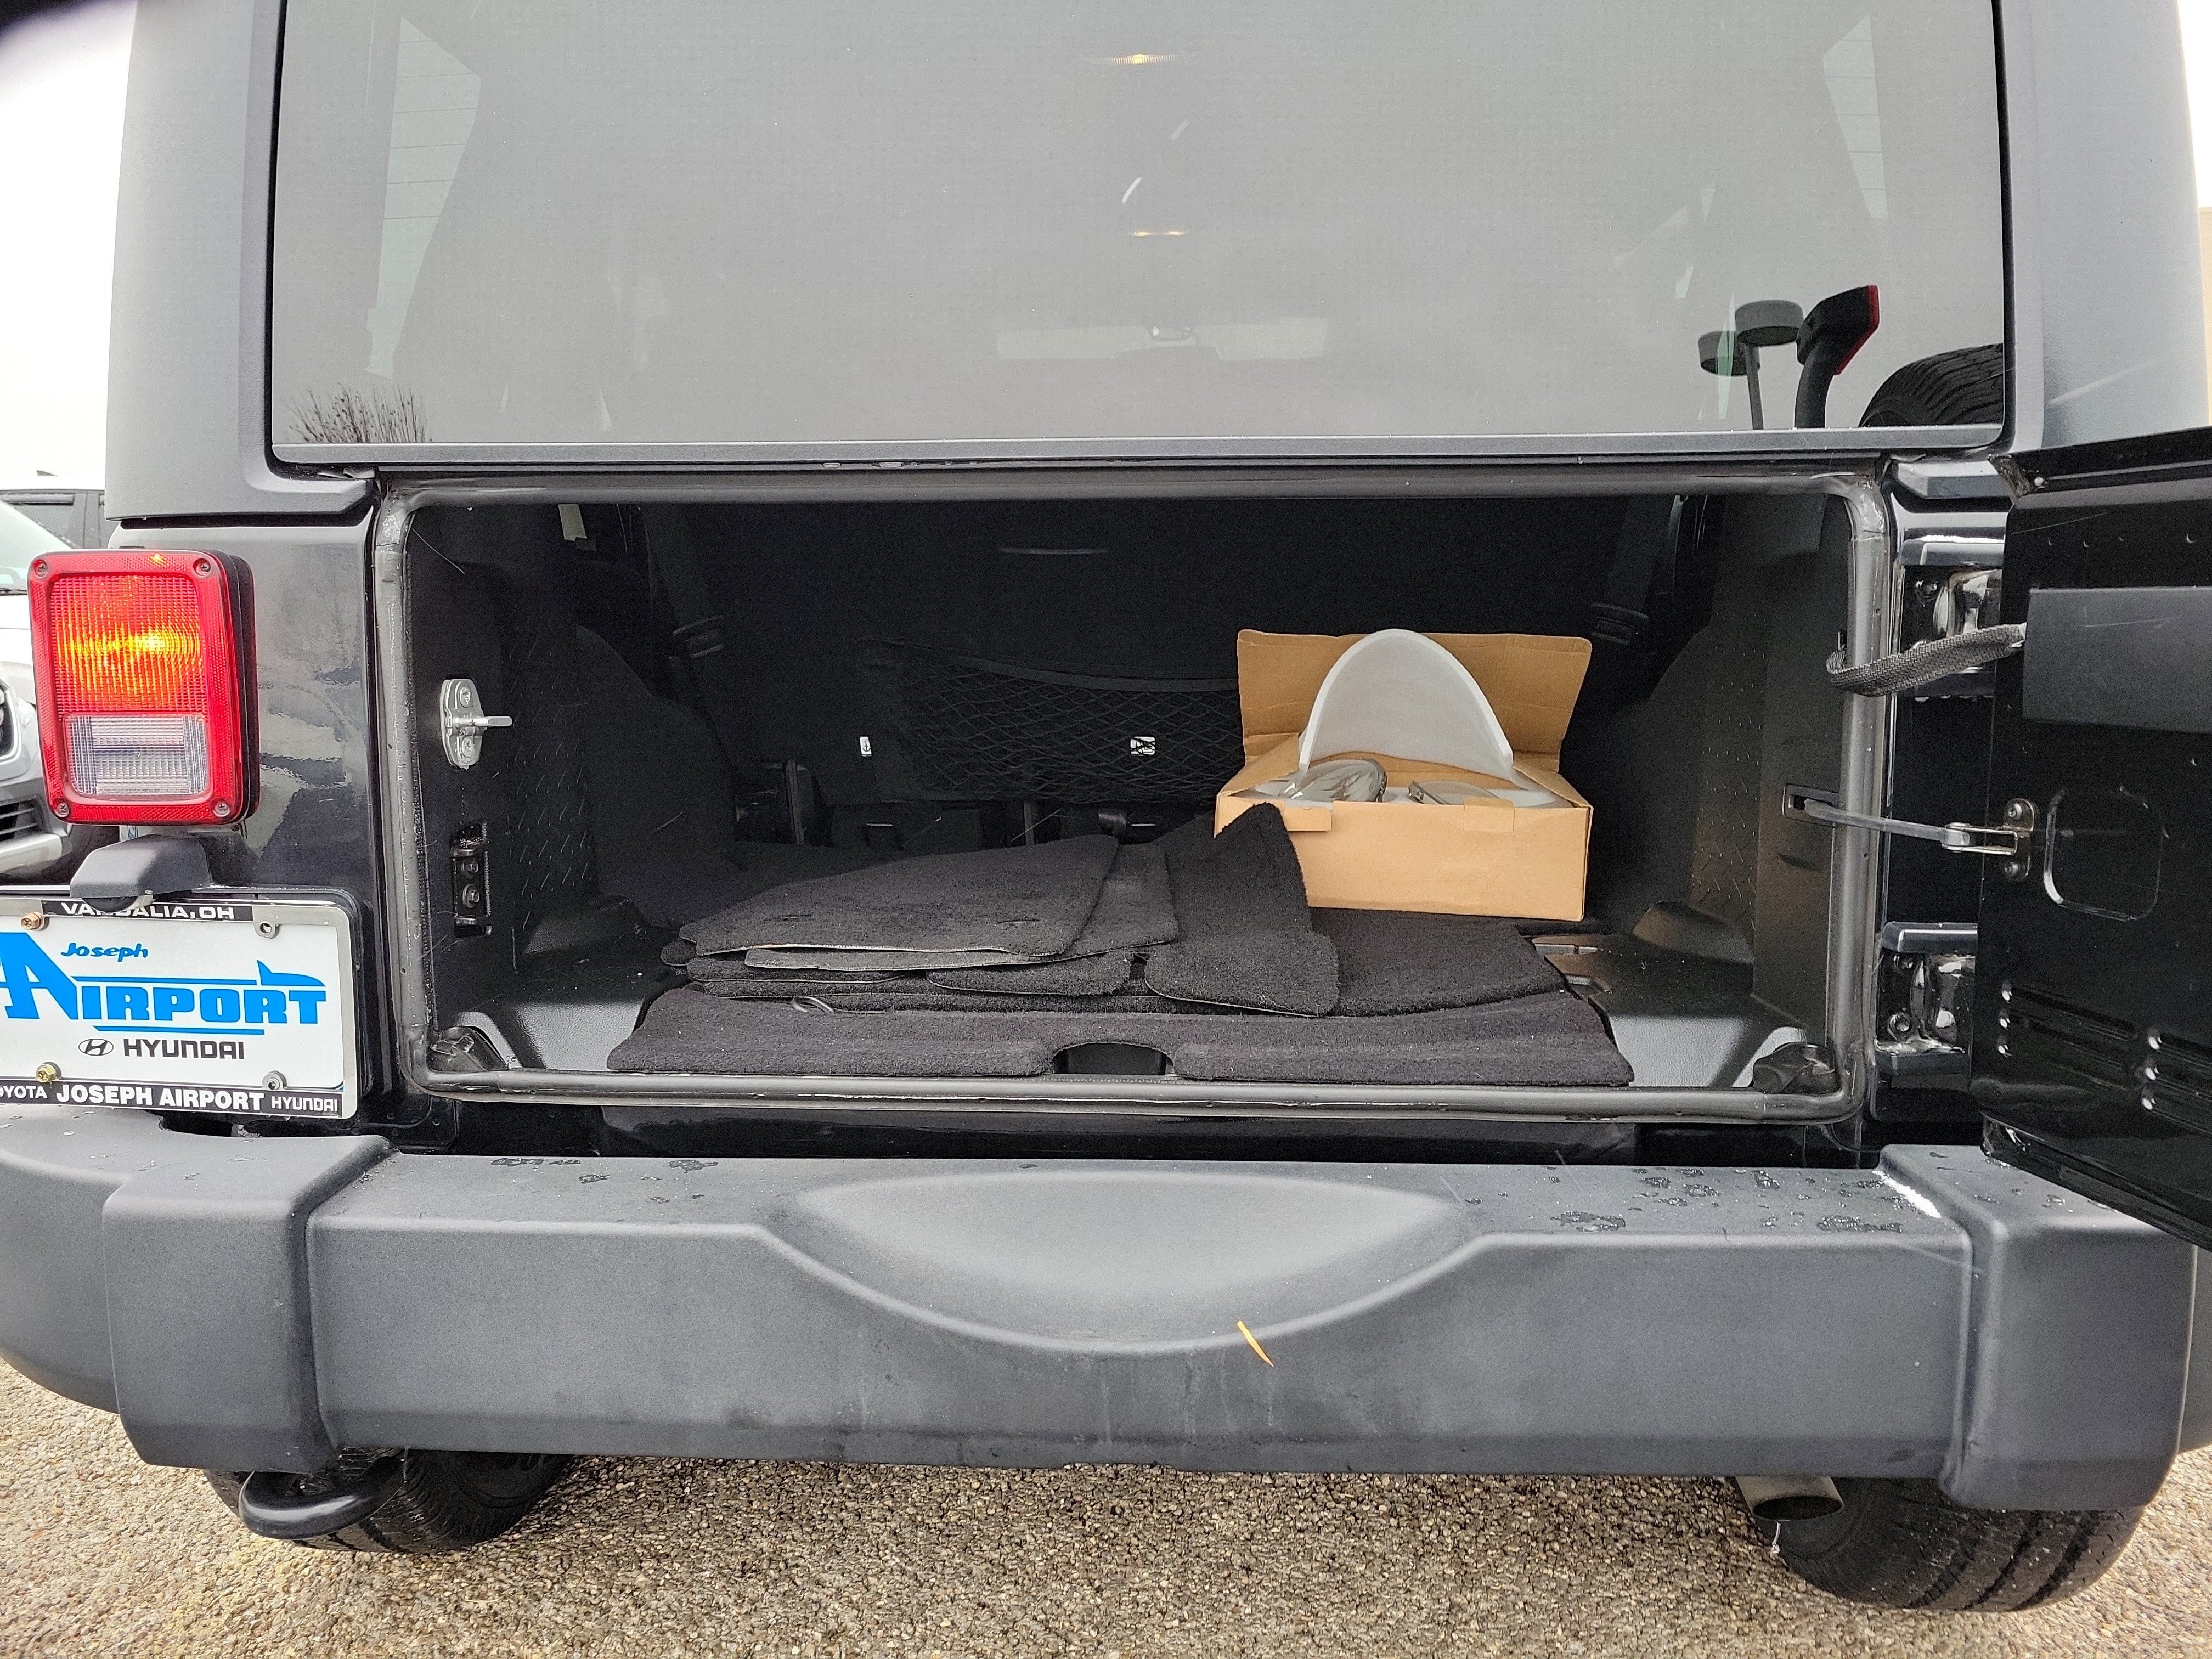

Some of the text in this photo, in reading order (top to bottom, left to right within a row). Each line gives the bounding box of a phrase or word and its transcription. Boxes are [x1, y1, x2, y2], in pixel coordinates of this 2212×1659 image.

[61, 943, 148, 962] Joseph
[0, 932, 326, 1024] AIRPORT
[123, 1039, 245, 1059] HYUNDAI
[56, 1084, 153, 1105] JOSEPH
[159, 1088, 264, 1111] AIRPORT
[271, 1096, 338, 1112] HYUNDAI
